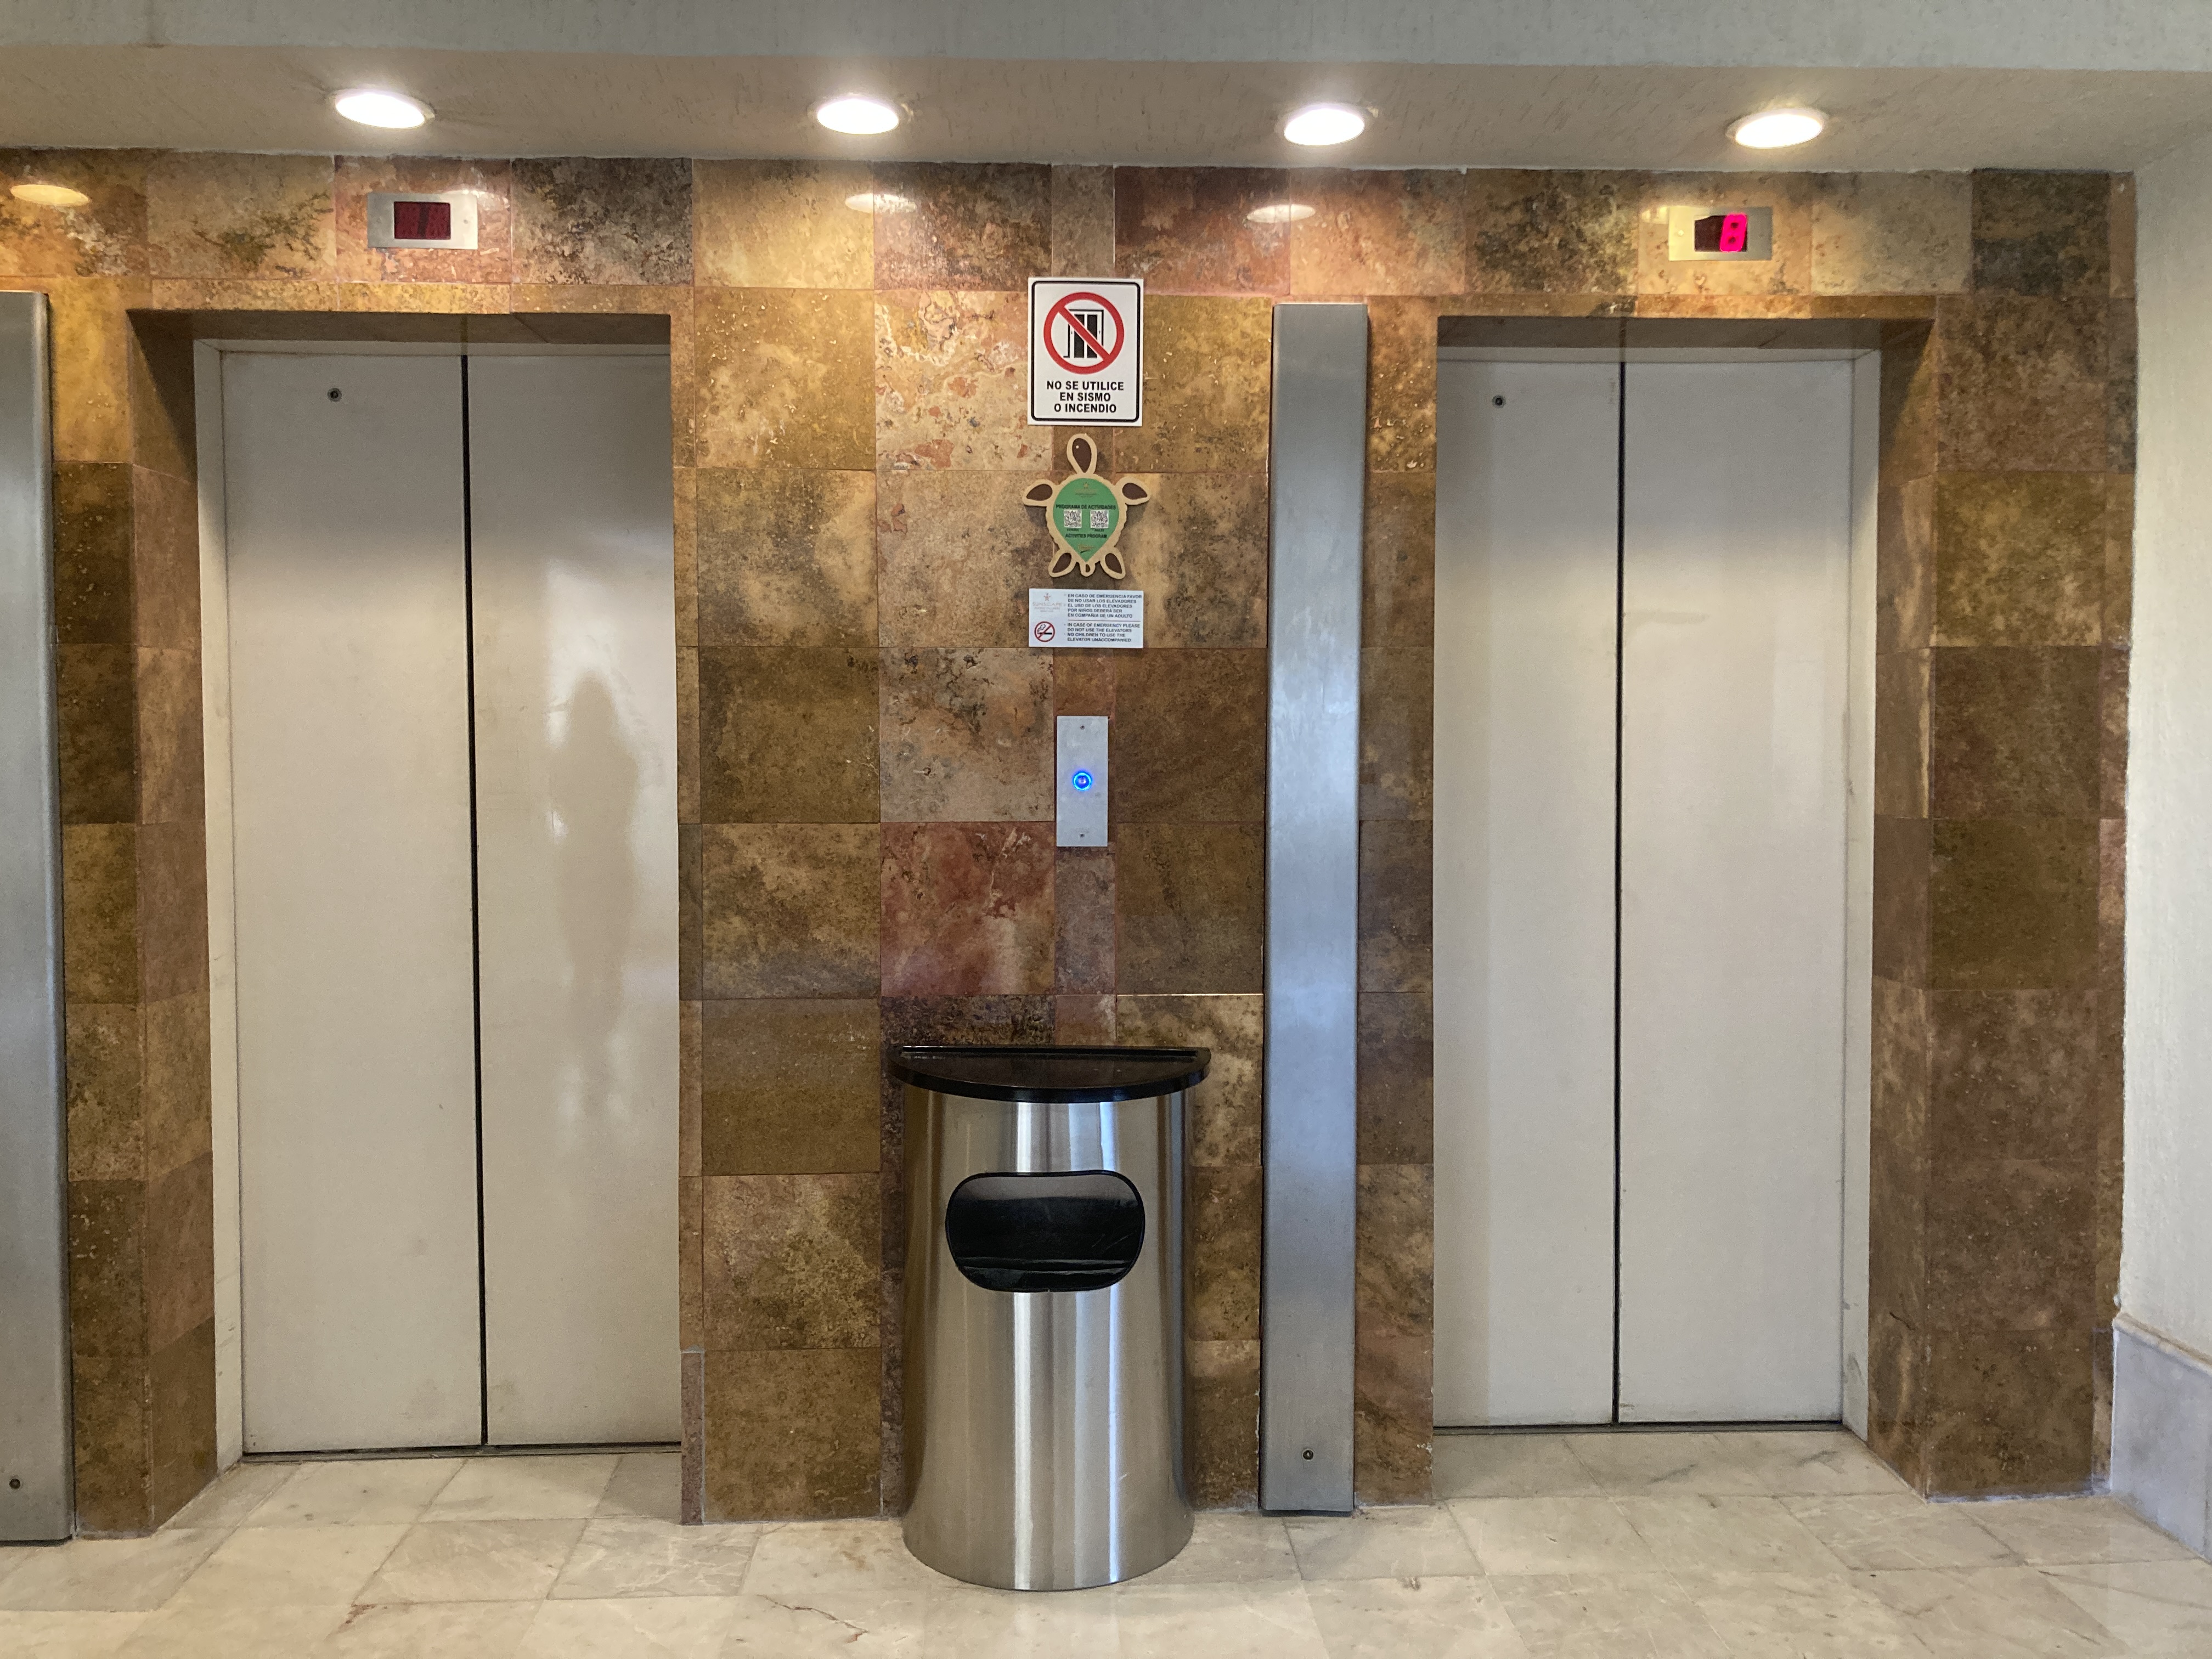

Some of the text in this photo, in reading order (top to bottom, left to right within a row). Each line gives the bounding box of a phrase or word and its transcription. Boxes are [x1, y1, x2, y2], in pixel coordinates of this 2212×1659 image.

[1047, 381, 1124, 391] NO SE UTILICE
[1060, 392, 1111, 402] EN SISMO
[1054, 403, 1116, 413] O INCENDIO
